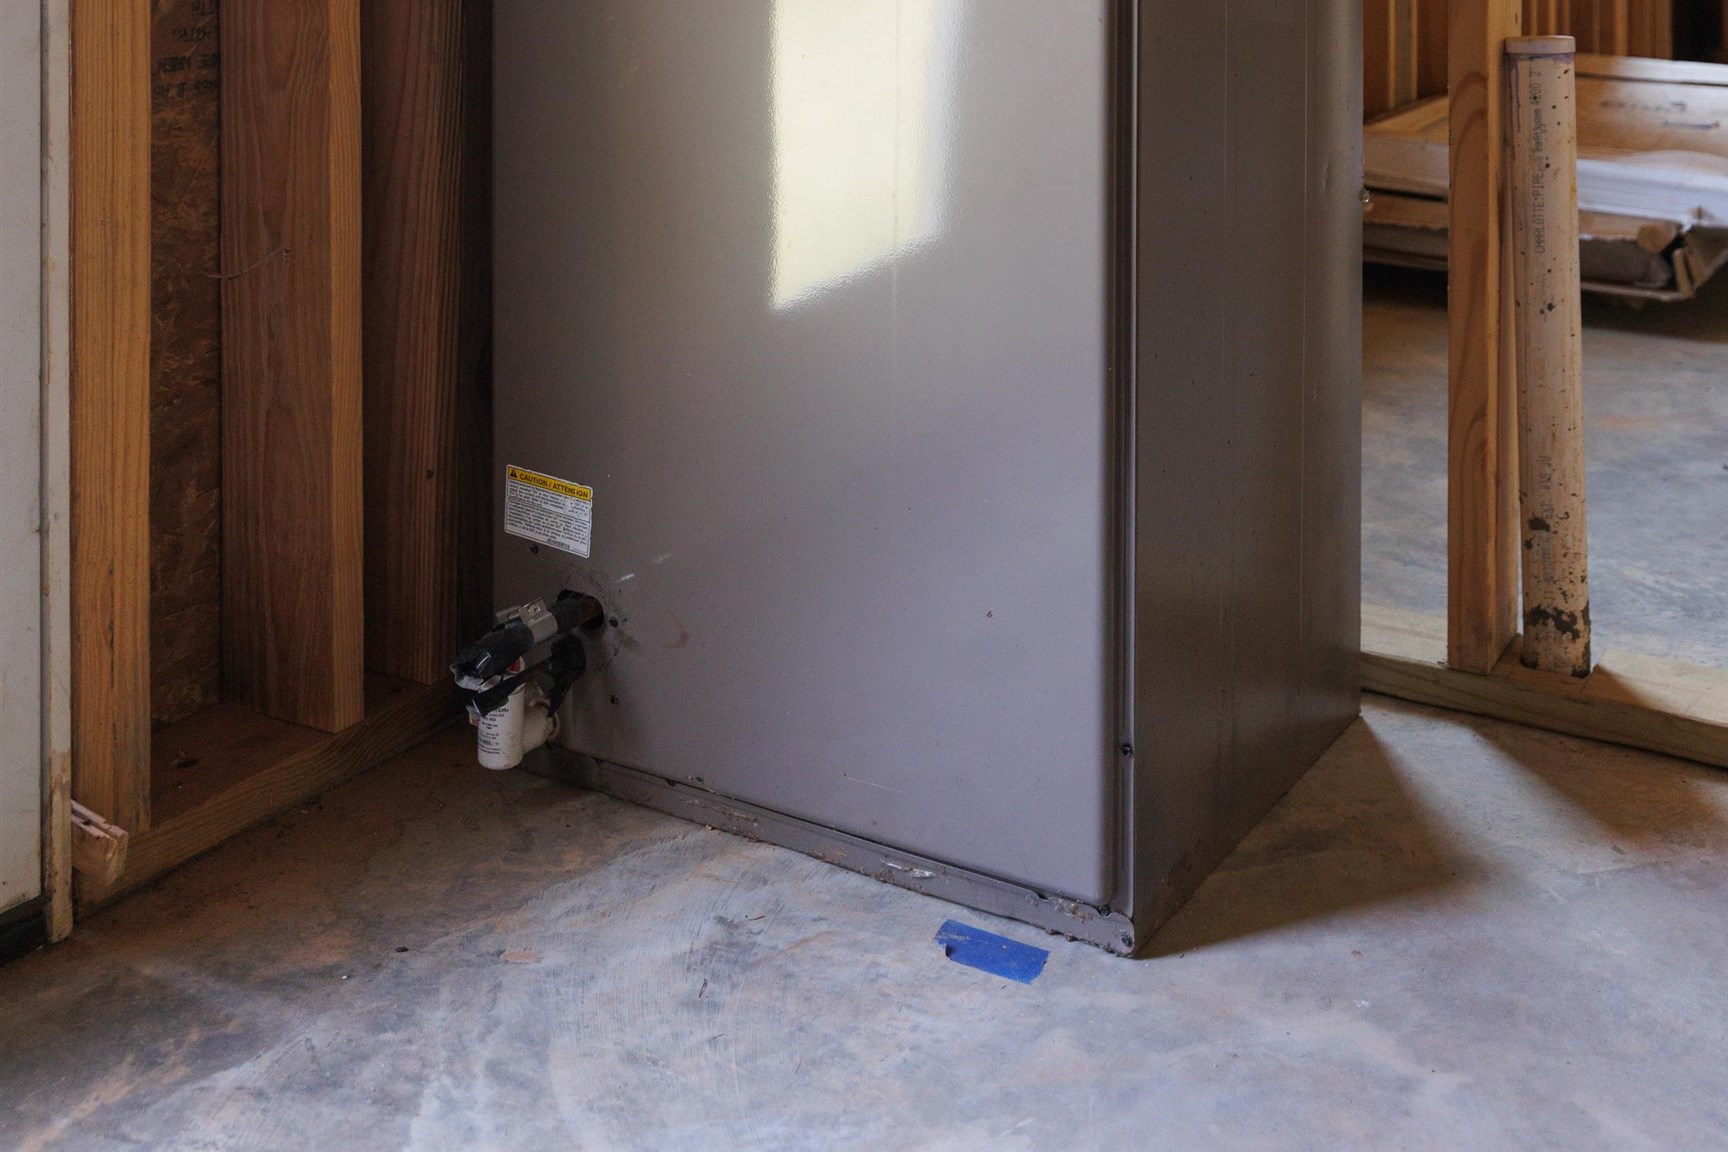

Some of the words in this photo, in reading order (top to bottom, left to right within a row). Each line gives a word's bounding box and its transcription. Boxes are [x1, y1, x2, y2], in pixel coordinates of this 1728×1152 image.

[1531, 173, 1545, 197] PIPE
[520, 473, 548, 487] CAUTION
[553, 483, 588, 498] ATTENTION
